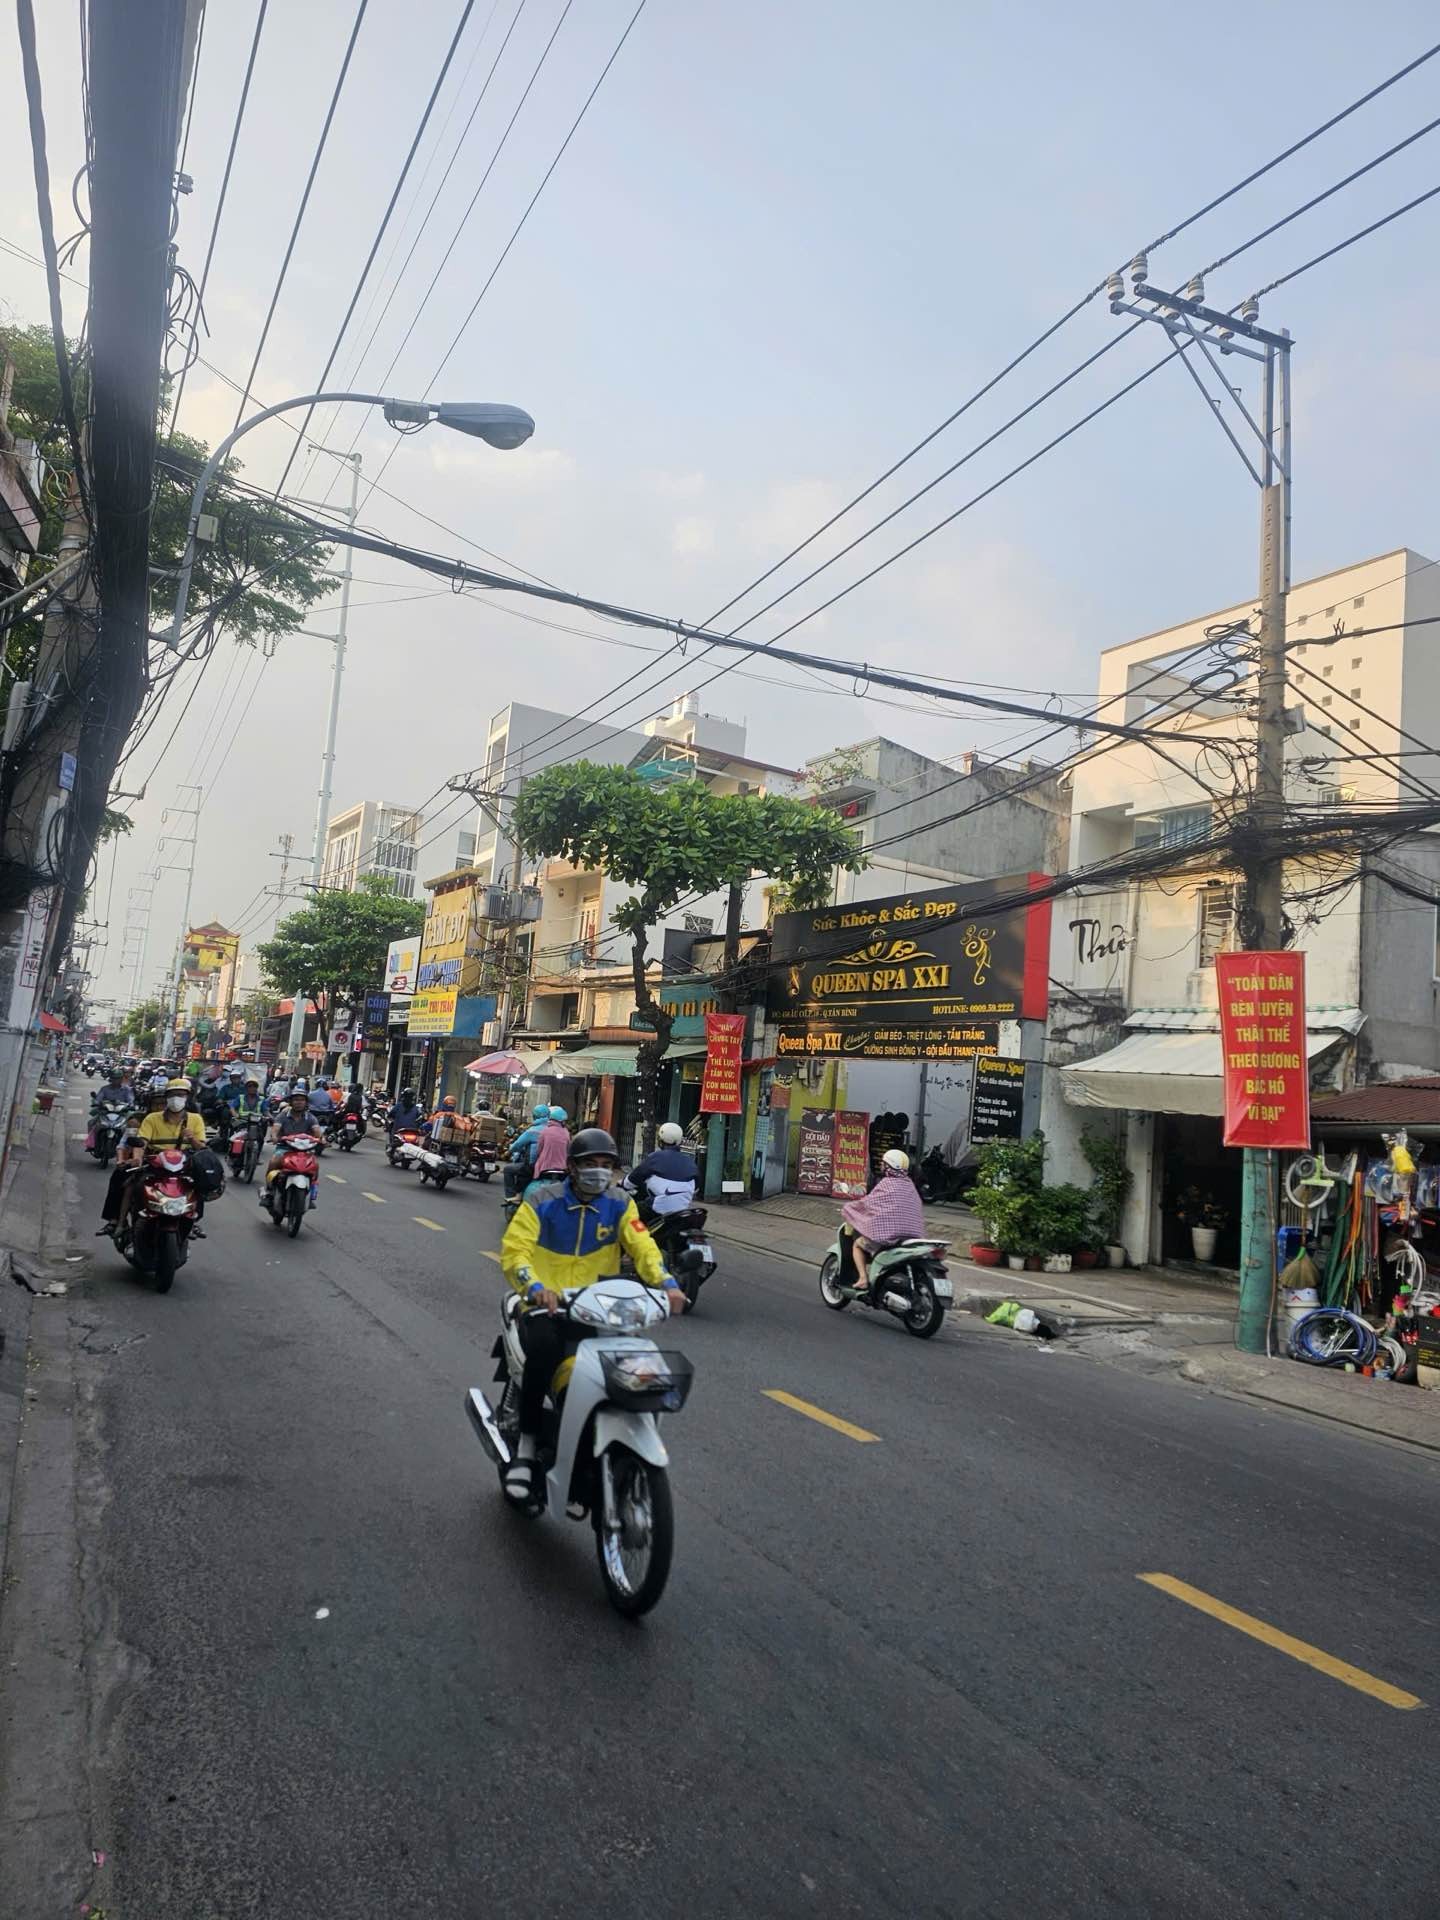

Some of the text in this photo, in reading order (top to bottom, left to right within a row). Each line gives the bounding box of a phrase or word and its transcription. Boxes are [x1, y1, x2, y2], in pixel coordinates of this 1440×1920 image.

[812, 914, 837, 932] Sức
[878, 909, 891, 923] &
[893, 899, 920, 921] Sắc
[924, 901, 957, 919] Đẹp
[812, 964, 951, 998] QUEEN SPA XXI
[1269, 972, 1293, 991] DÂN
[1230, 999, 1254, 1017] RÈN
[779, 1032, 805, 1053] Queen
[806, 1032, 823, 1054] Spa
[823, 1032, 841, 1051] XXI
[978, 1057, 1024, 1076] Queen Spa
[1229, 1053, 1259, 1068] THEO
